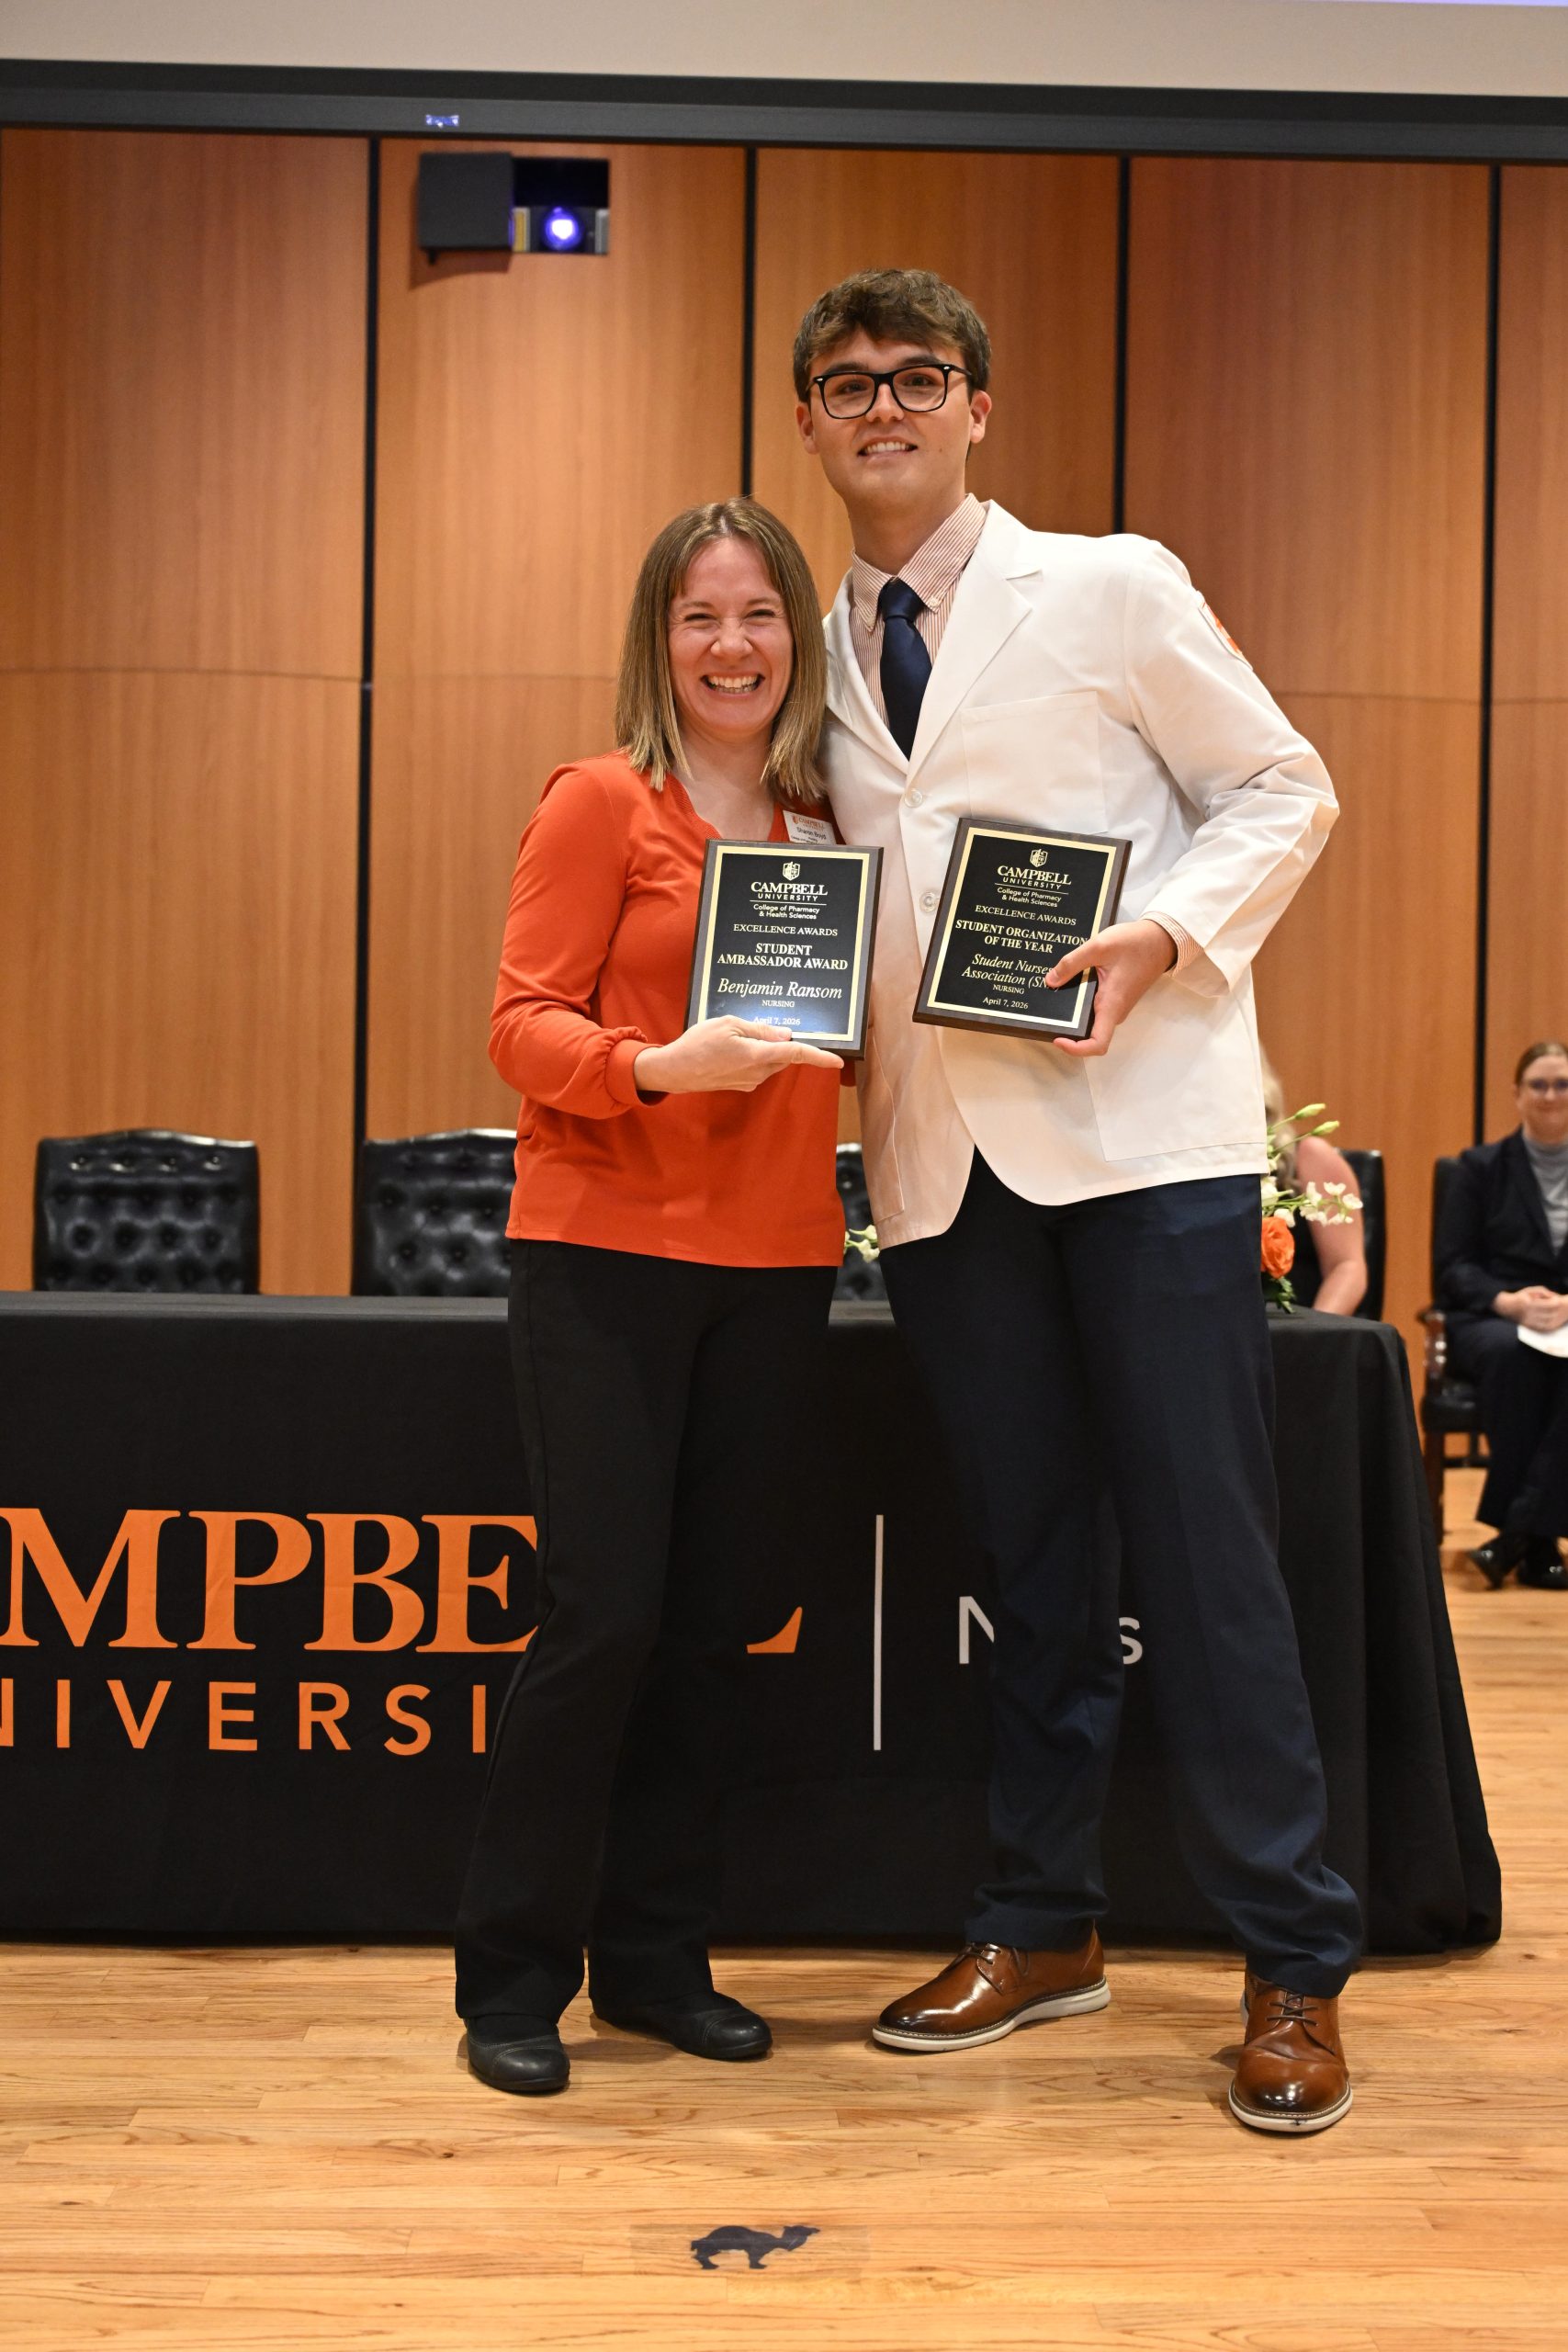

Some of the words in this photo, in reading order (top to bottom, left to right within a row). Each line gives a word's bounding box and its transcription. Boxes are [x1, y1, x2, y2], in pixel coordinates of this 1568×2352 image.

[998, 865, 1072, 885] CAMPBELL
[750, 881, 828, 895] CAMPBELL
[1003, 876, 1061, 889] UNIVERSITY
[758, 893, 818, 901] UNIVERSITY
[997, 888, 1021, 896] College
[1032, 891, 1062, 902] Pharmacy
[753, 904, 778, 912] College
[1031, 899, 1057, 907] Sciences
[975, 904, 1035, 920] EXCELLENCE
[1037, 914, 1077, 925] AWARDS
[734, 924, 795, 934] EXCELLENCE
[797, 927, 838, 936] AWARDS
[955, 920, 1004, 935] STUDENT
[1006, 927, 1089, 946] ORGANIZATION
[756, 943, 812, 956] STUDENT
[985, 935, 1000, 944] OF
[1001, 938, 1022, 948] THE
[1025, 942, 1053, 953] YEAR
[717, 955, 801, 967] AMBASSADOR
[804, 959, 848, 969] AWARD
[972, 954, 1014, 969] Student
[962, 967, 1026, 985] Association
[717, 978, 783, 998] Benjamin
[786, 981, 842, 999] Ransom
[993, 984, 1024, 994] NURSING
[983, 997, 1001, 1006] April
[753, 1016, 773, 1024] April
[773, 1017, 781, 1025] 7,
